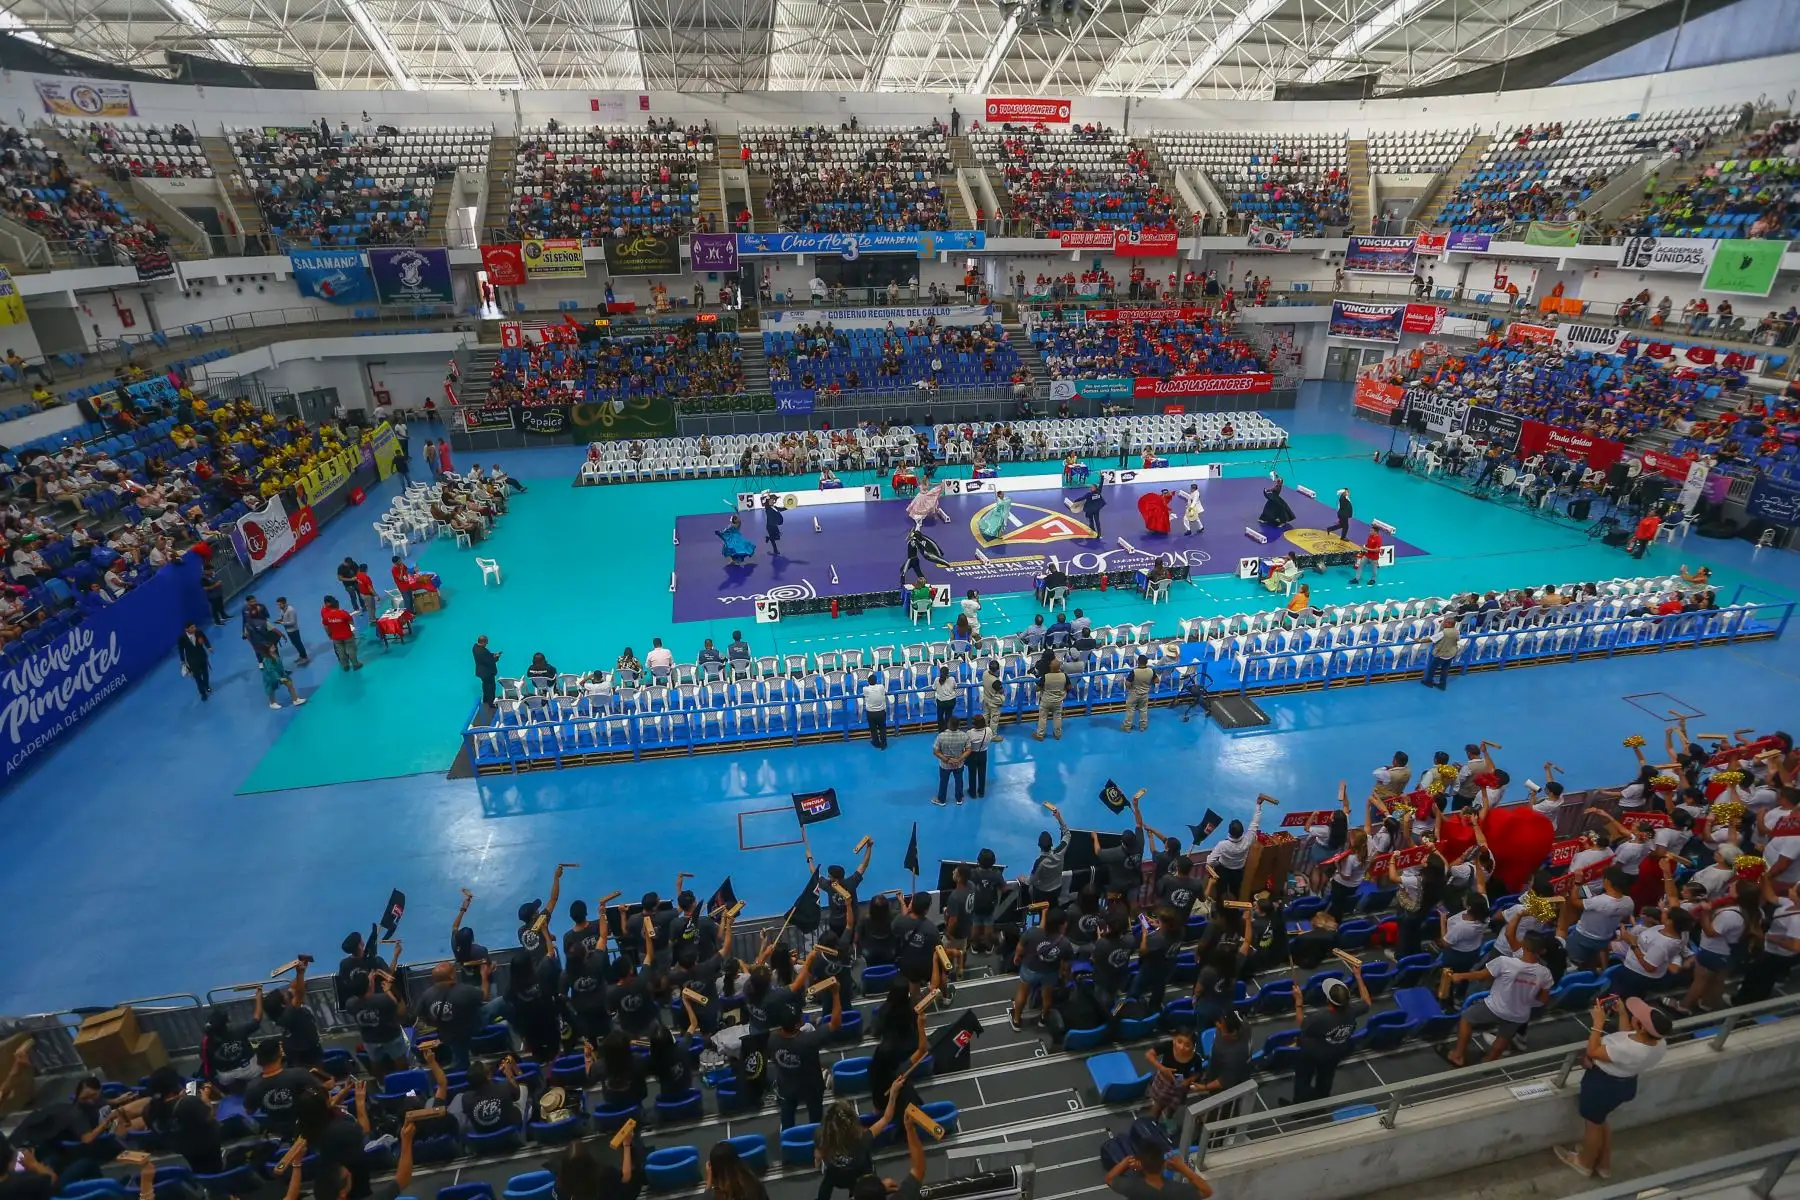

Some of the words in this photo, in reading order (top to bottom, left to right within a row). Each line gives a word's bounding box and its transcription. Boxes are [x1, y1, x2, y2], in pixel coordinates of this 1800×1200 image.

[1000, 104, 1018, 115] TODAS
[1030, 105, 1056, 115] SANGRES
[781, 235, 815, 252] Chio
[842, 238, 859, 262] 3
[1359, 239, 1413, 247] VINCULATV
[1657, 246, 1704, 255] ACADEMIAS
[1655, 254, 1700, 264] UNIDAS
[828, 309, 867, 320] GOBIERNO
[868, 308, 906, 318] REGIONAL
[907, 308, 921, 317] DEL
[923, 307, 951, 316] CALLAO
[1341, 303, 1398, 315] VINCULATV
[505, 328, 518, 347] 3
[1567, 325, 1620, 345] UNIDAS
[1155, 380, 1187, 393] TODAS
[1187, 380, 1207, 391] LAS
[1205, 378, 1253, 391] SANGRES
[1108, 470, 1115, 484] 2
[1215, 465, 1221, 477] 1
[872, 485, 881, 499] 4
[952, 480, 960, 494] 3
[745, 494, 755, 508] 5
[1386, 547, 1392, 564] 1
[946, 561, 1022, 572] Marinera
[1245, 559, 1256, 577] 2
[939, 587, 950, 606] 4
[768, 602, 779, 621] 5
[2, 627, 94, 695] Michelle
[0, 631, 121, 744] Pimentel
[5, 723, 64, 775] ACADEMIA
[65, 713, 79, 727] DE
[80, 673, 128, 716] MARINERA
[815, 803, 826, 812] TV
[1375, 854, 1411, 872] PITA
